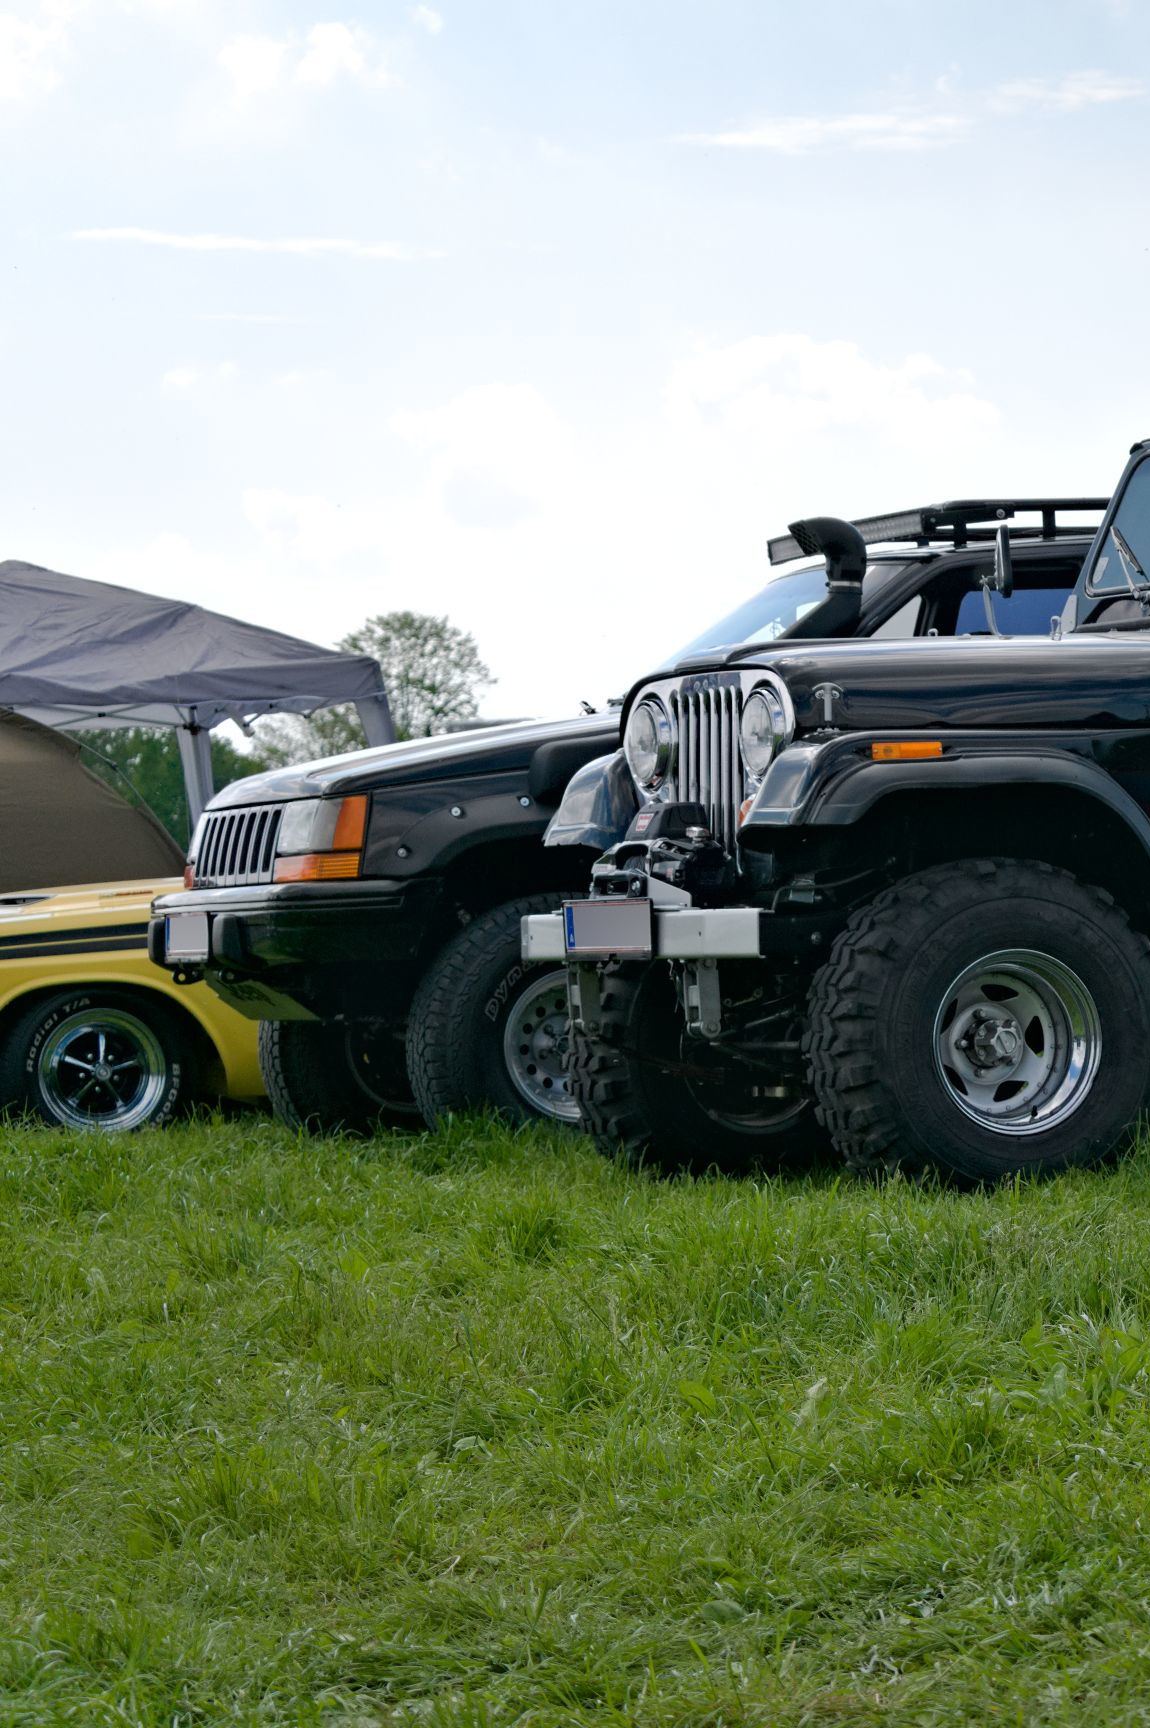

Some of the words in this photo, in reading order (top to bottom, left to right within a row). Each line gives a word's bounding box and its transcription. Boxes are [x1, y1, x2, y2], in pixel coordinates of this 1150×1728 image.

[484, 958, 544, 1022] Dyna
[26, 1013, 58, 1072] Radial
[62, 997, 90, 1013] T/A
